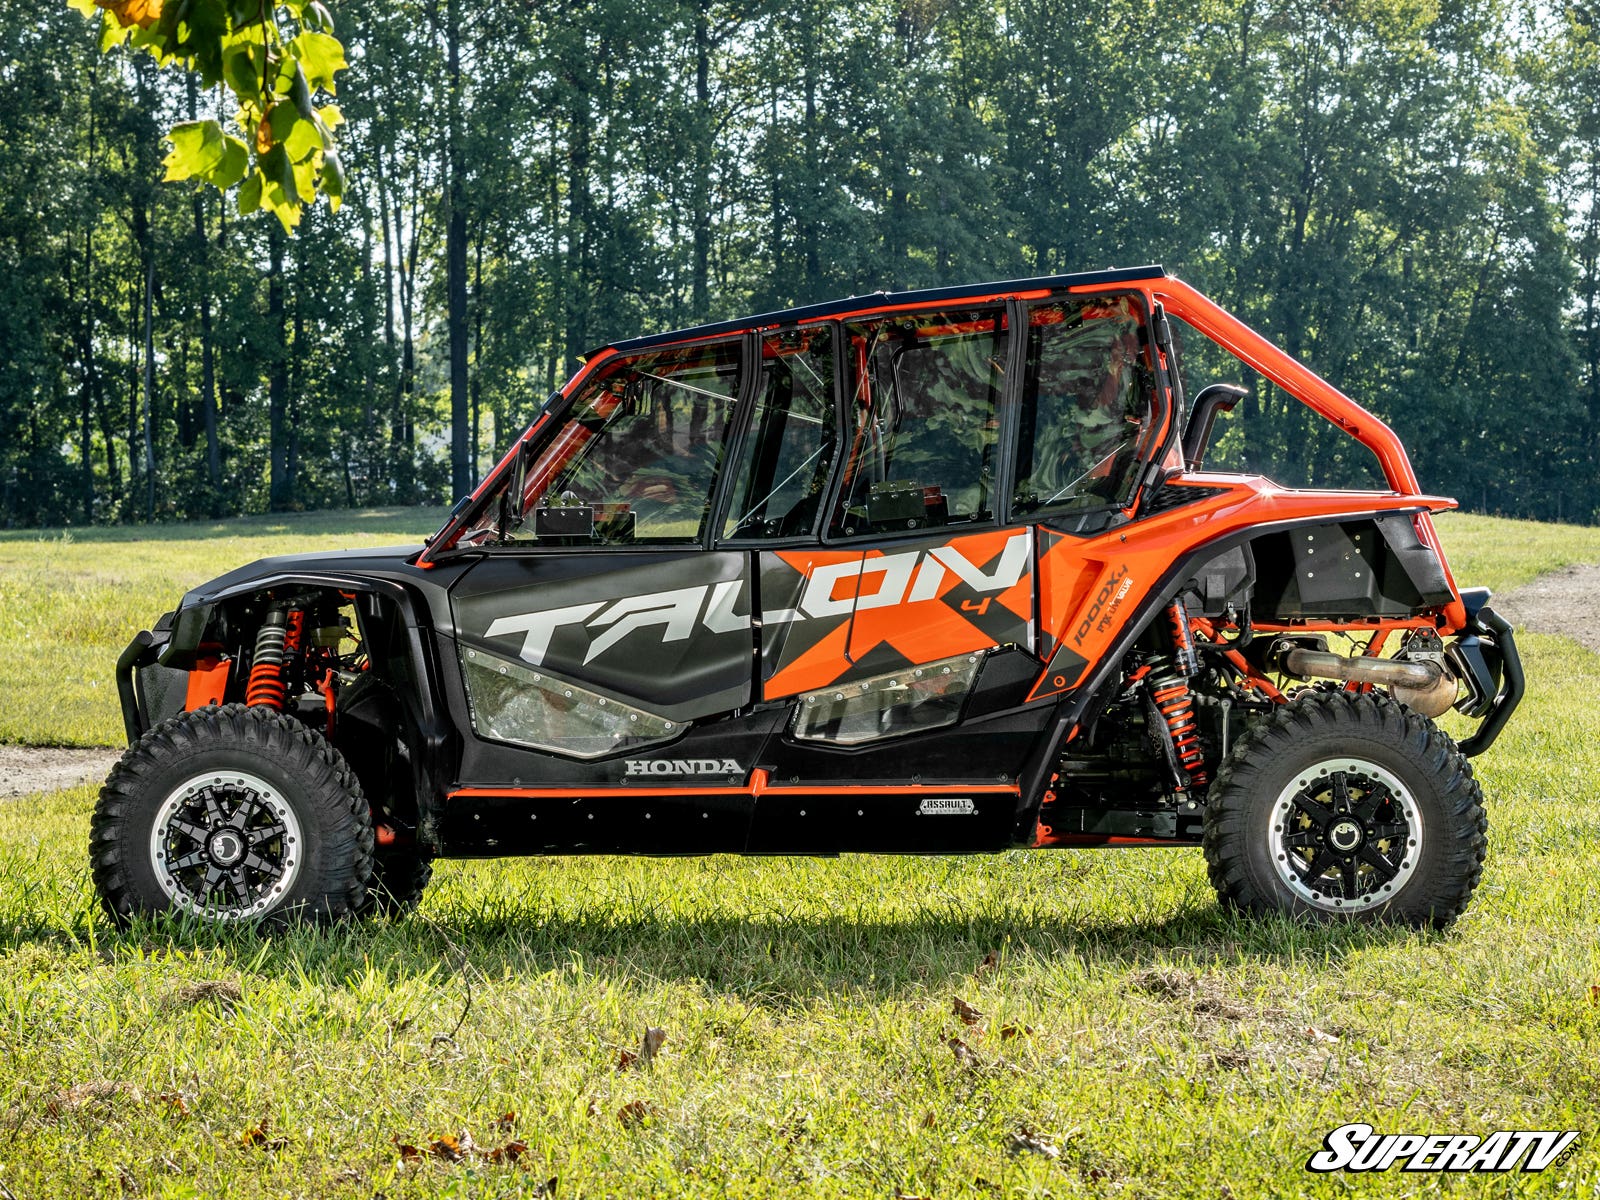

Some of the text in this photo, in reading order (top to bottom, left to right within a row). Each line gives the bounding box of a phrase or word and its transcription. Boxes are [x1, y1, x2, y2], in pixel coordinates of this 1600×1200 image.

[483, 533, 1032, 667] TALON
[960, 597, 992, 615] 4
[624, 759, 745, 775] HONDA
[926, 800, 967, 809] ASSAULT
